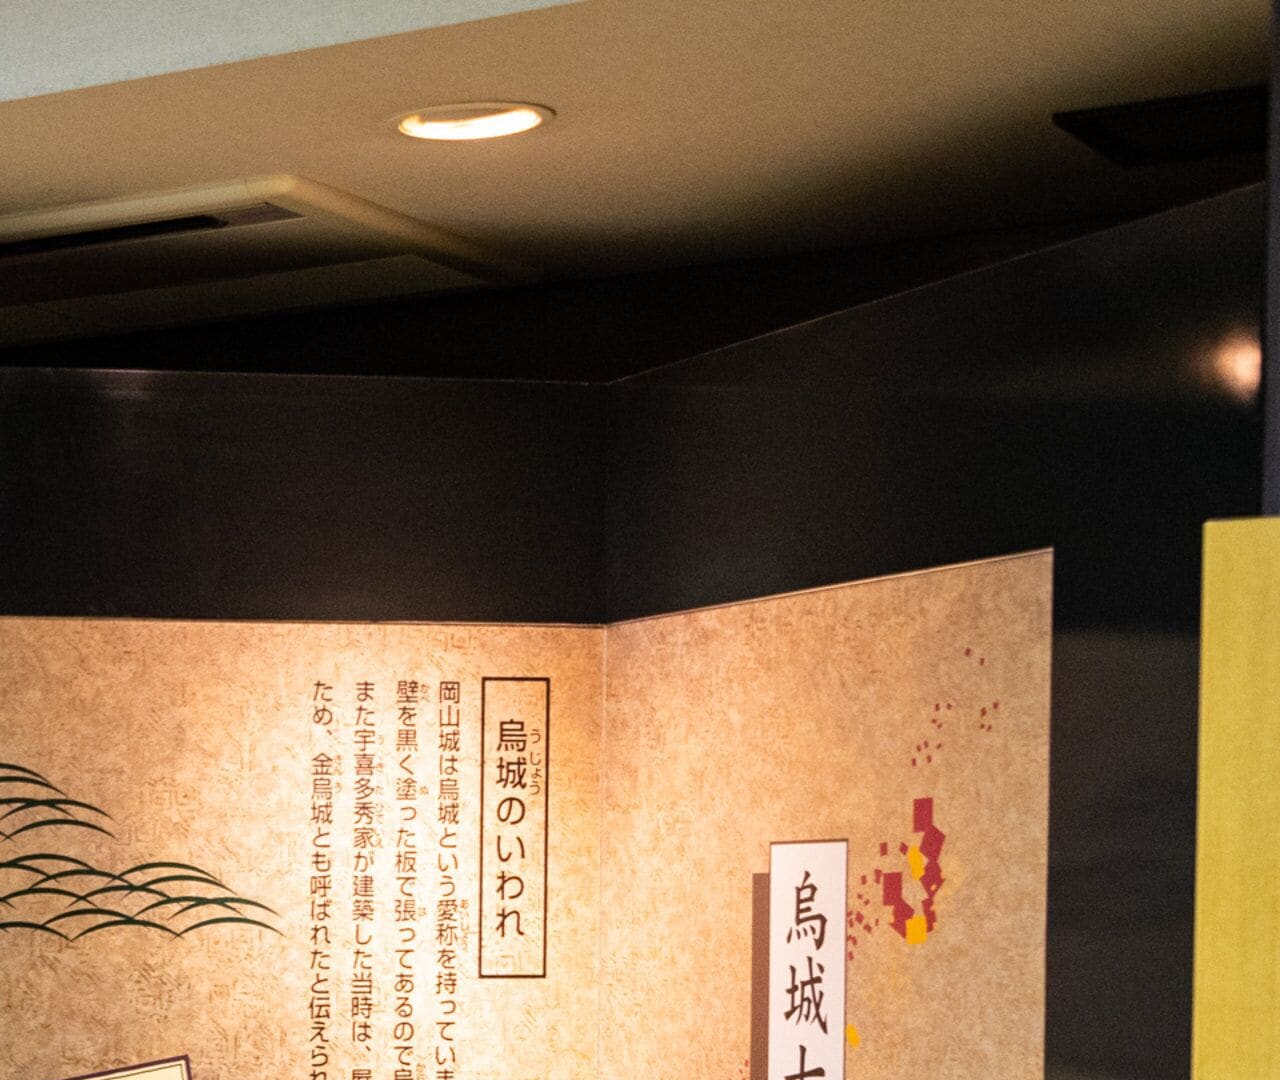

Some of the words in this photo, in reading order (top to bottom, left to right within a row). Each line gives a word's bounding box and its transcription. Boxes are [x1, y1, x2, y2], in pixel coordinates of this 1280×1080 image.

[495, 718, 528, 937] 烏城のいわれ
